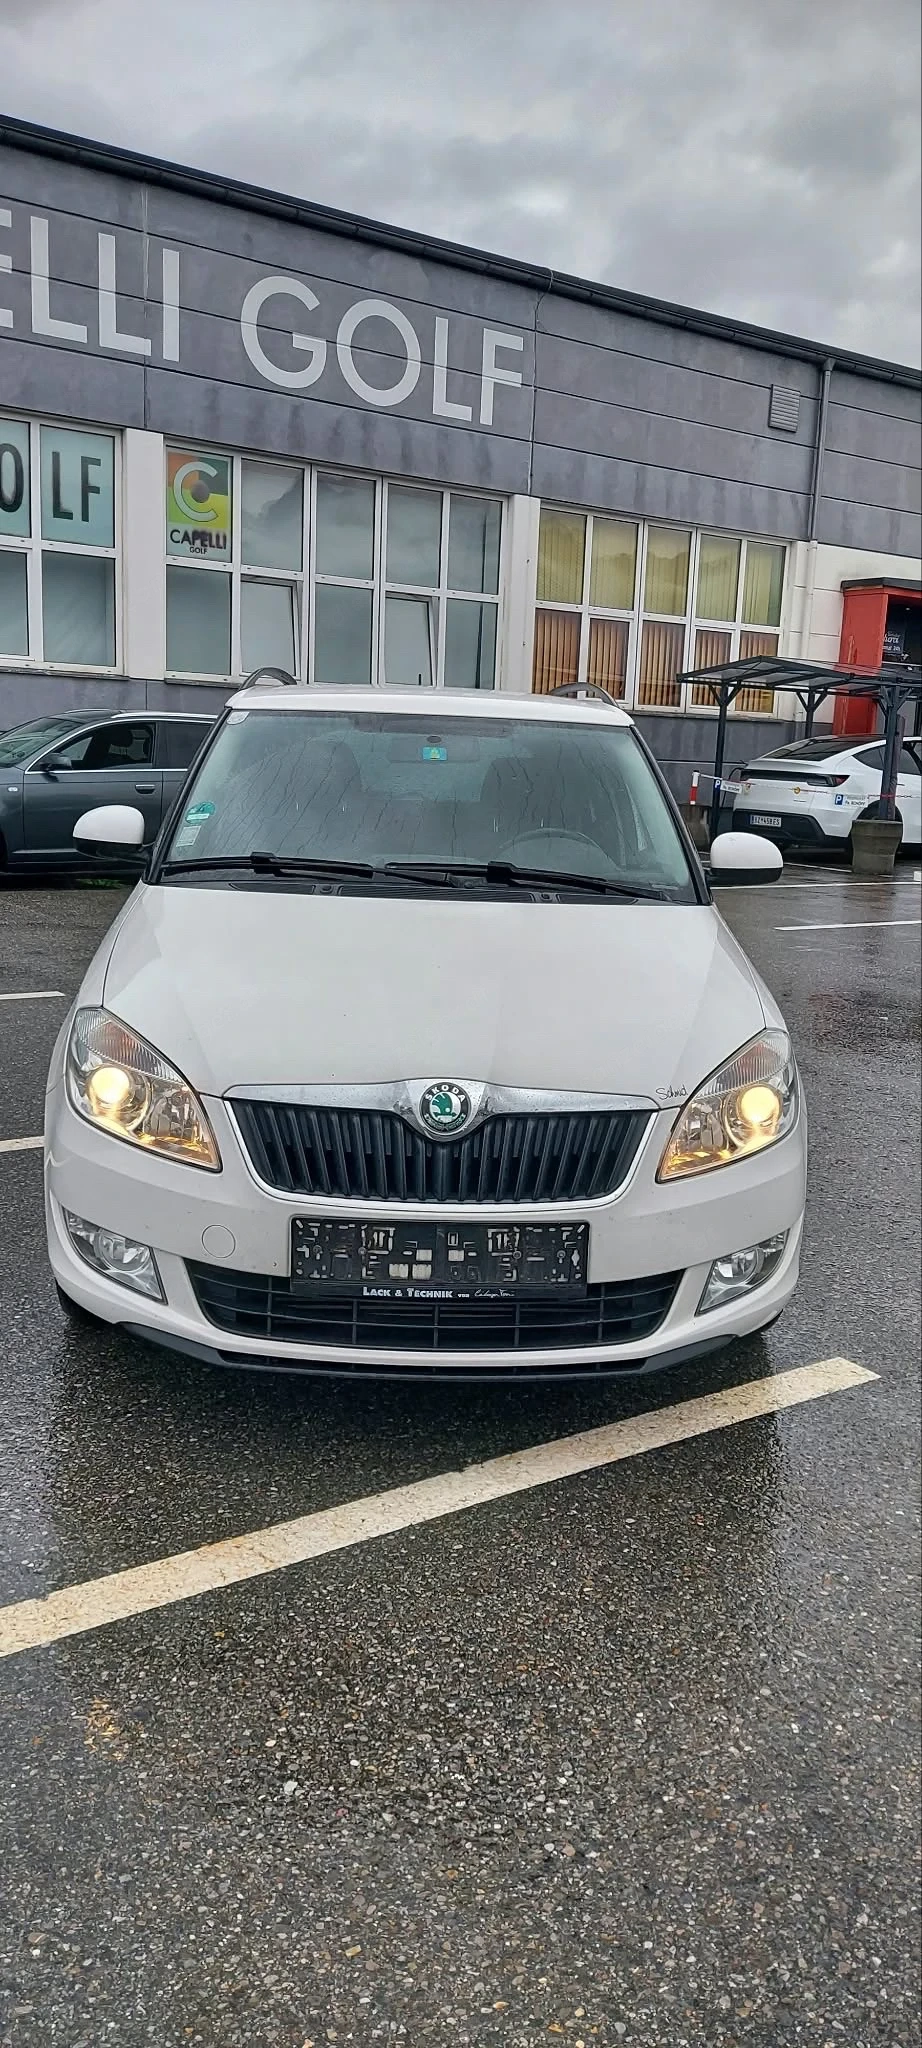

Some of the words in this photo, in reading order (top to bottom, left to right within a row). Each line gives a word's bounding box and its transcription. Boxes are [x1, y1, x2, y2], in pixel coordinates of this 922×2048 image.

[0, 208, 180, 363] LLI
[240, 275, 524, 426] GOLF
[170, 529, 227, 550] CAPELLI
[190, 546, 208, 555] GOLF
[394, 1289, 403, 1297] &
